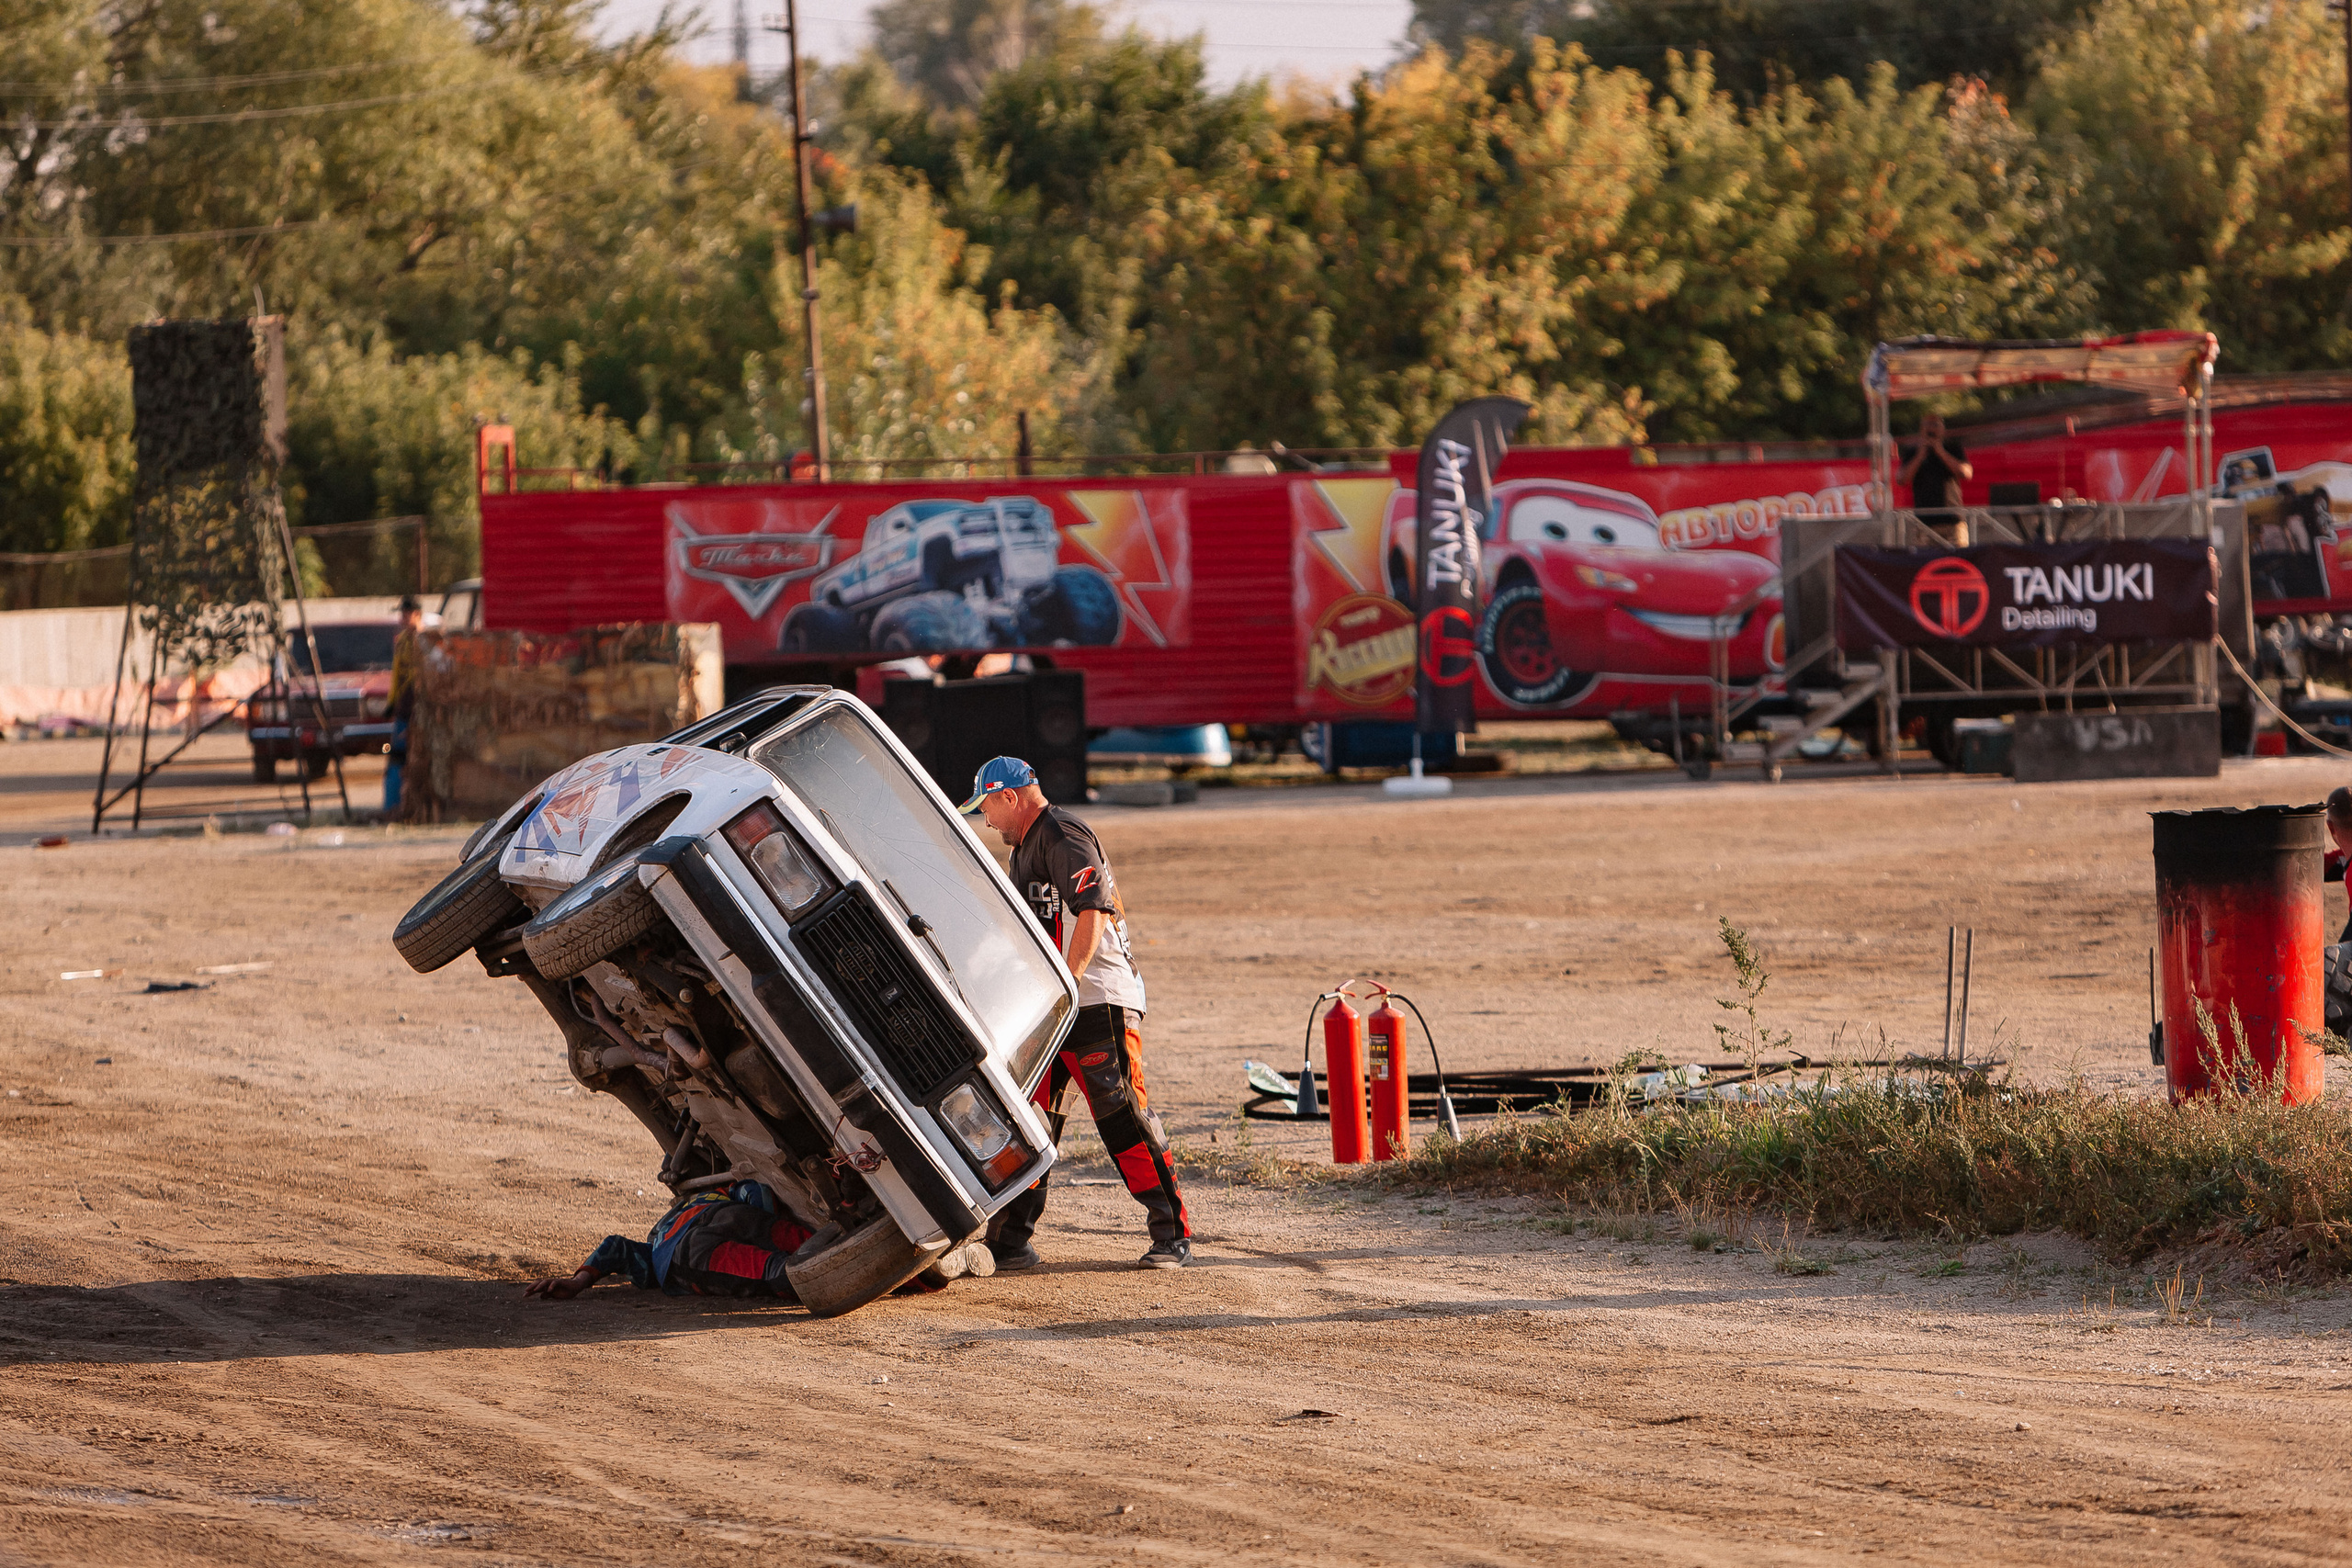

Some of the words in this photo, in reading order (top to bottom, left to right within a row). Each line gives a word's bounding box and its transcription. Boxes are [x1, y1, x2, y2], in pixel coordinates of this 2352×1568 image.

[1426, 437, 1473, 592] TANUKI
[2002, 562, 2154, 604] TANUKI
[2001, 604, 2098, 633] Detailing
